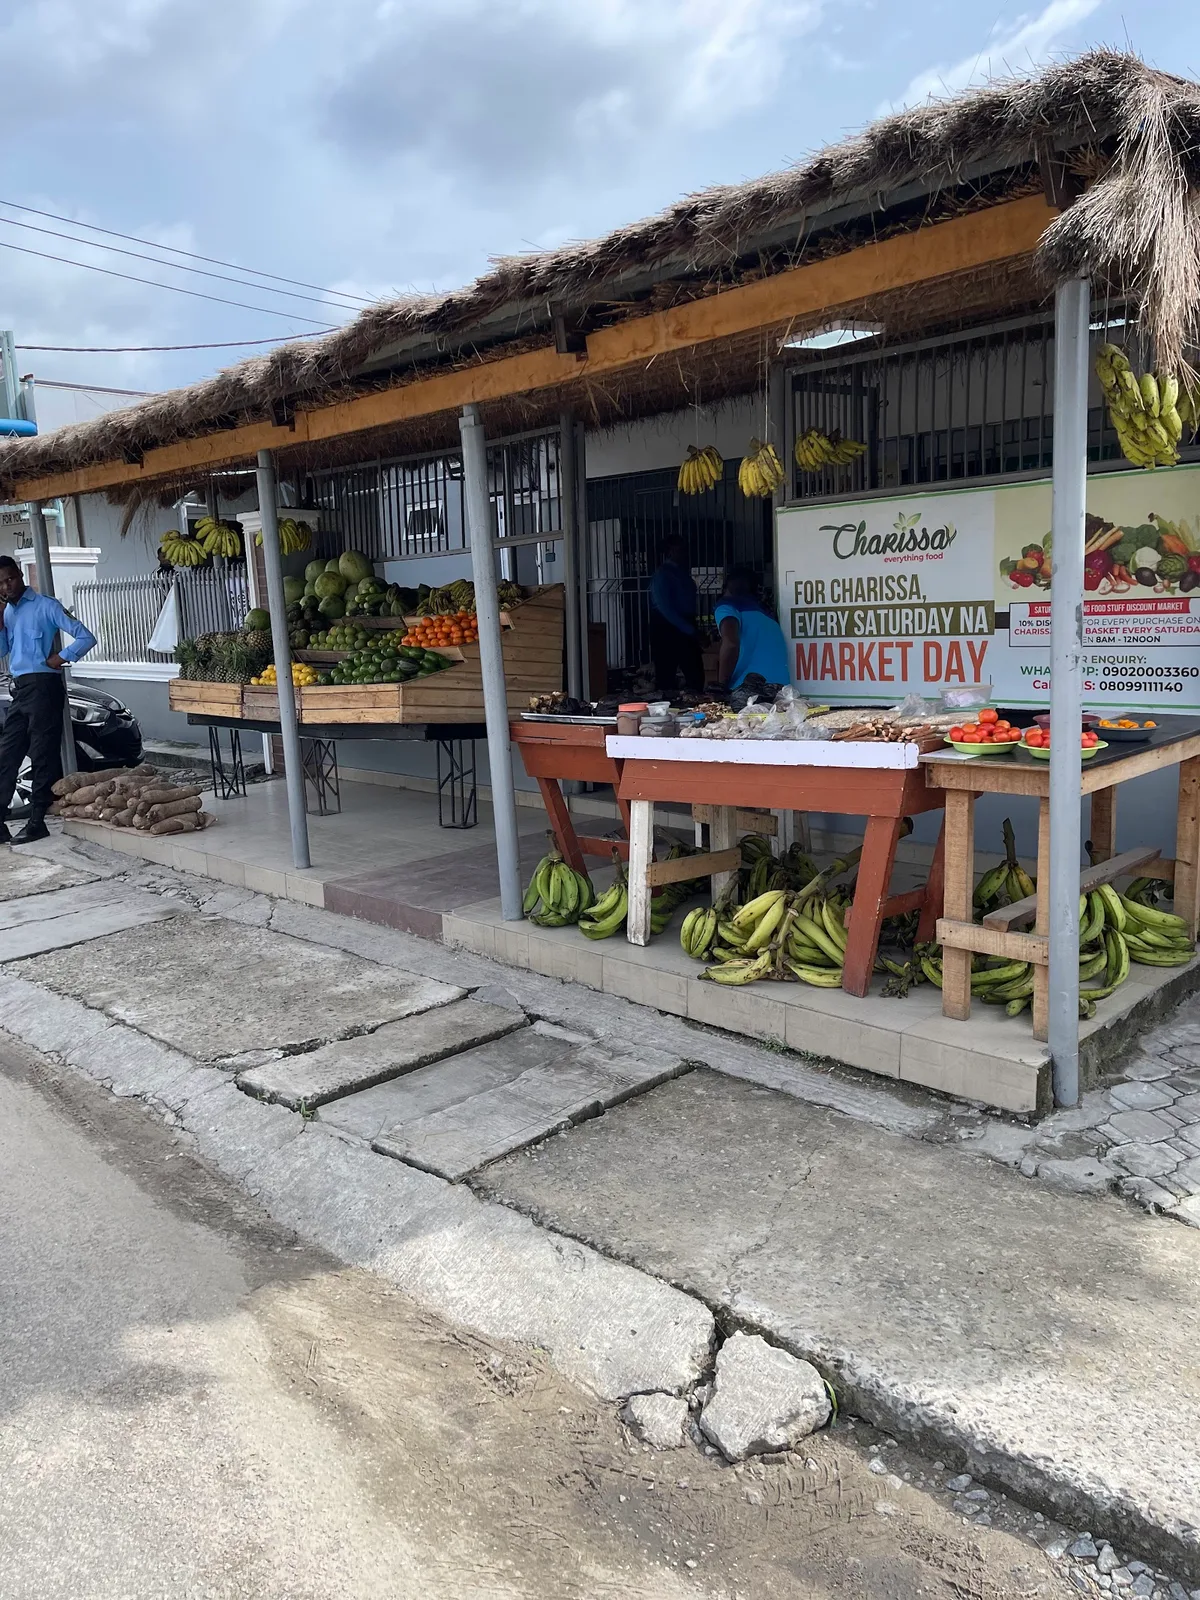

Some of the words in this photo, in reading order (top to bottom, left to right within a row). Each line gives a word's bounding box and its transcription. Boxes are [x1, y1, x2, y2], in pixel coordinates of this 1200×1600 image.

[819, 518, 957, 559] Charissa
[884, 553, 924, 563] everything
[926, 552, 943, 560] food
[794, 579, 825, 605] FOR
[831, 574, 926, 603] CHARISSA,
[1107, 604, 1125, 612] STUFF
[1126, 603, 1156, 612] DISCOUNT
[1157, 602, 1184, 611] MARKET
[795, 610, 849, 636] EVERY
[854, 606, 954, 635] SATURDAY
[960, 606, 988, 633] NA
[1102, 618, 1130, 626] EVERY
[1133, 617, 1183, 625] PURCHASE
[1086, 627, 1120, 635] BASKET
[795, 641, 914, 682] MARKET
[923, 640, 989, 683] DAY
[1092, 655, 1147, 665] ENQUIRY:
[1102, 666, 1199, 677] 09020003360
[1100, 681, 1183, 692] 08099111140
